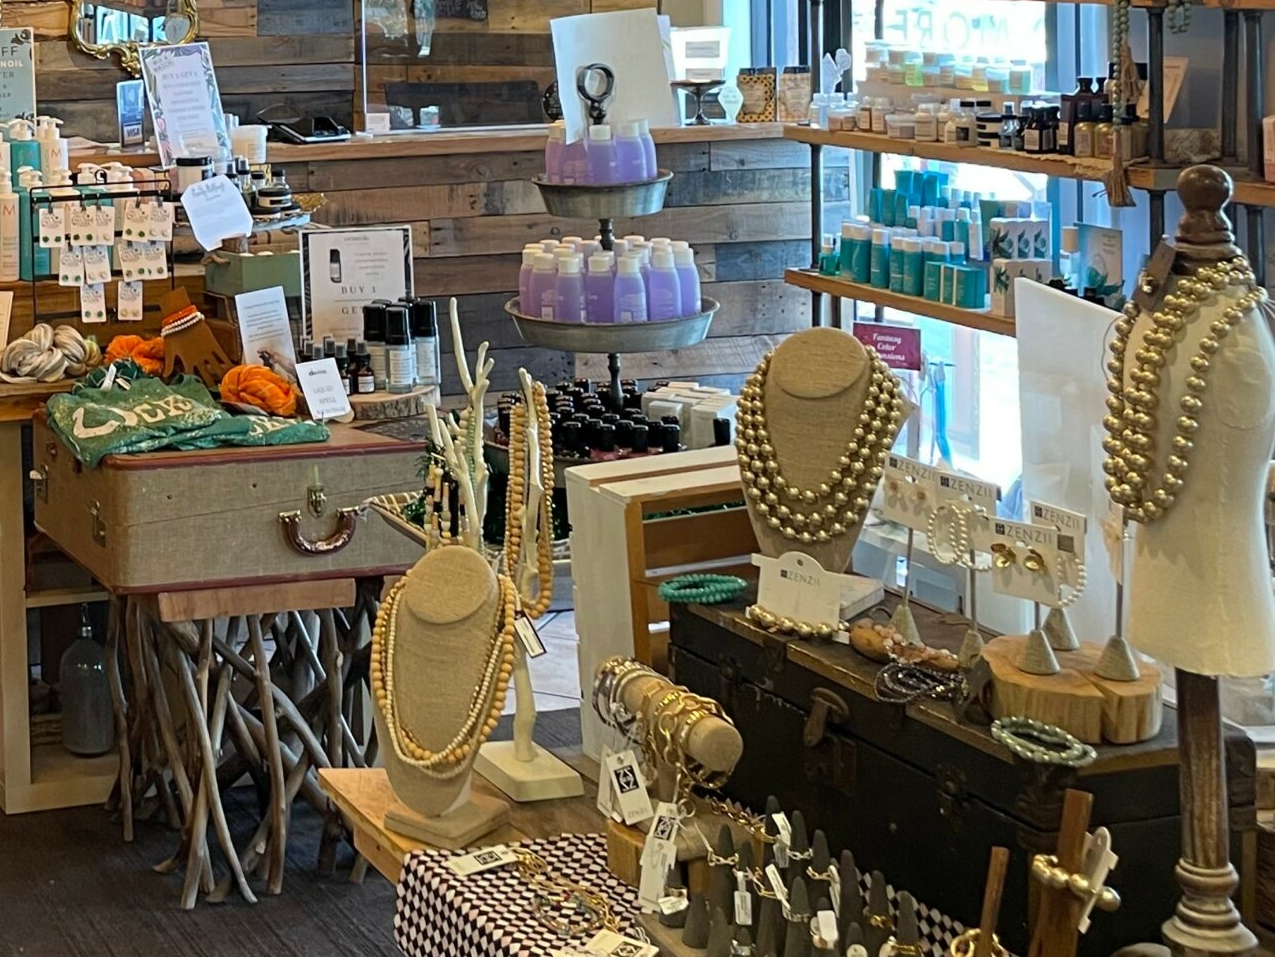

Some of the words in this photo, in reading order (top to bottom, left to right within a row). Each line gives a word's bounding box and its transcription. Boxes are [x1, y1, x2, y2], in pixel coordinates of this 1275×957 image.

[341, 285, 366, 295] BUY
[872, 332, 902, 345] Fantasy
[876, 343, 897, 351] Color
[897, 459, 935, 481] ZENZII
[948, 477, 993, 498] ZENZII
[1043, 508, 1081, 530] ZENZII
[1004, 525, 1053, 544] ZENZII
